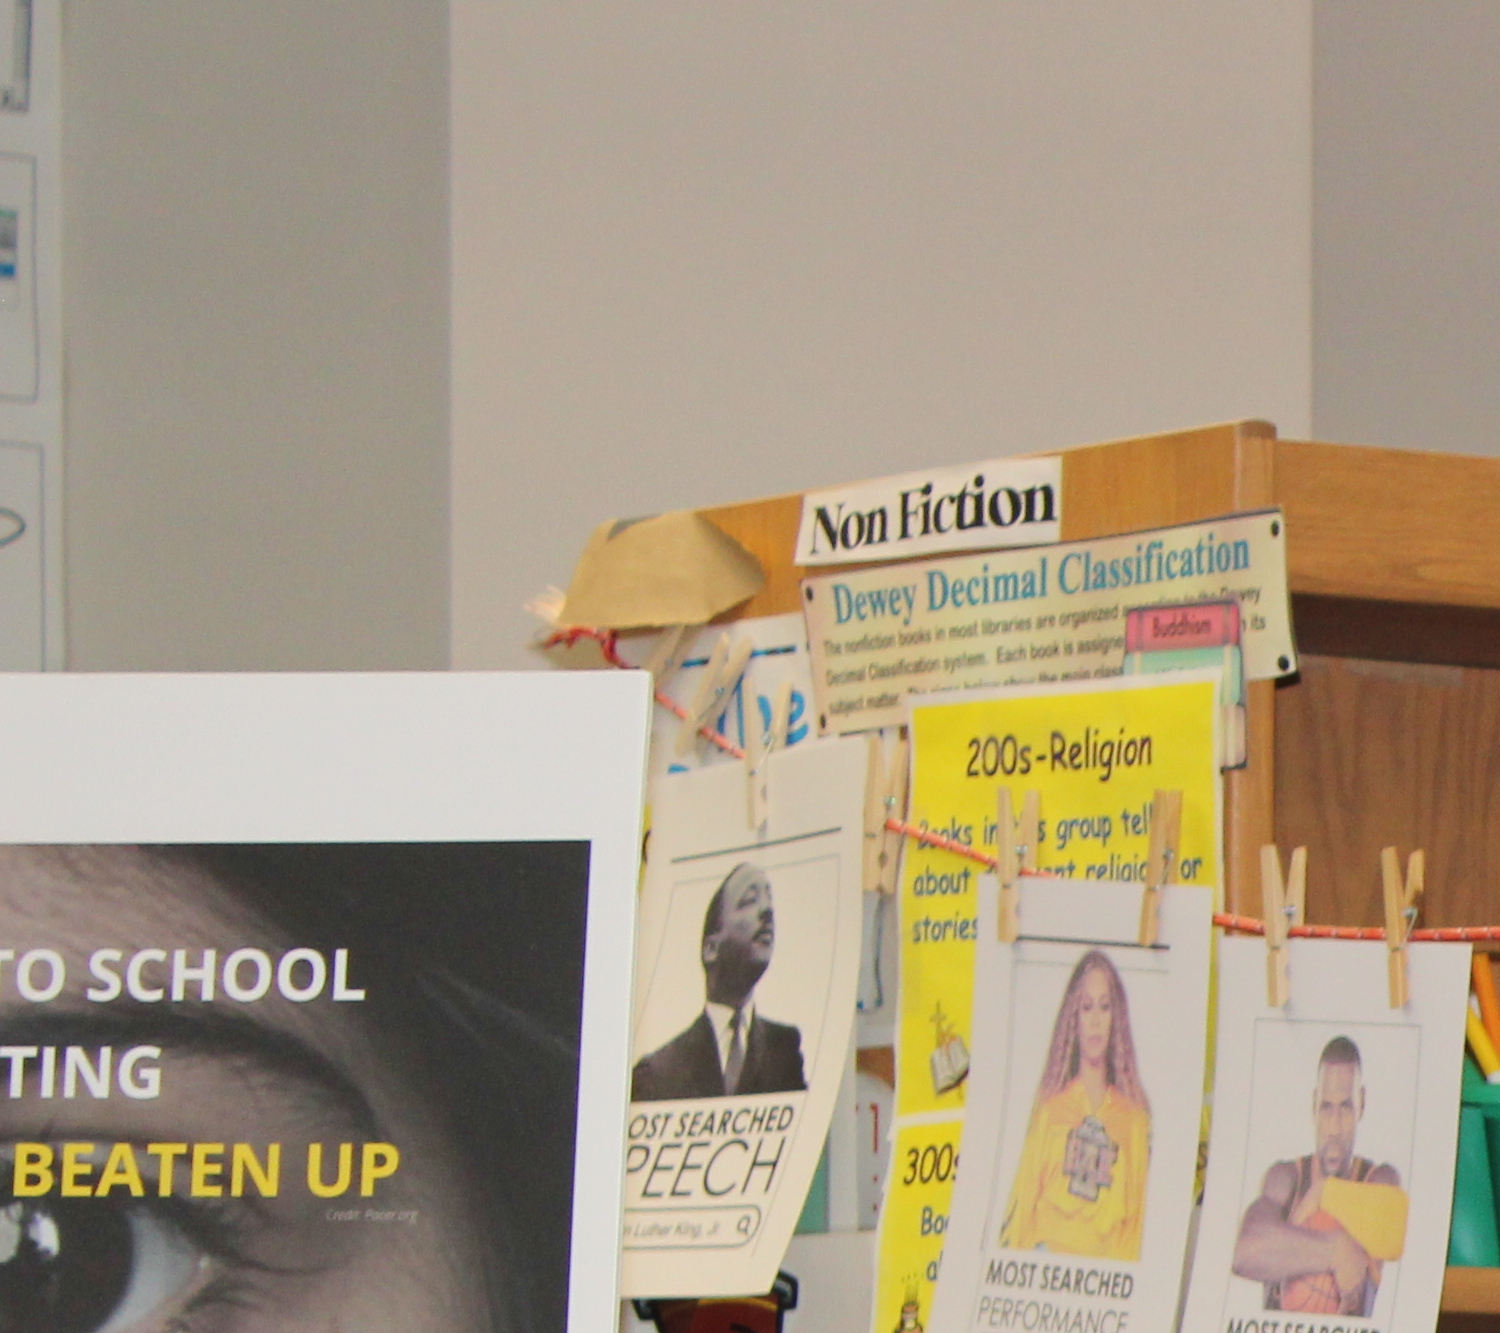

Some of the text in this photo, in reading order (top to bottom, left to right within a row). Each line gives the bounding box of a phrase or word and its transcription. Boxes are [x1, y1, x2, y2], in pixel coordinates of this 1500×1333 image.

[809, 474, 1057, 555] Non Fiction
[833, 532, 1251, 626] Dewey Decimal Classification
[965, 728, 1153, 780] 200s-Religion
[1056, 805, 1113, 850] group
[912, 857, 1204, 896] about or
[86, 947, 367, 1003] SCHOOL
[673, 1104, 795, 1139] SEARCHED
[12, 1141, 401, 1199] BEATEN UP
[985, 1258, 1134, 1299] MOST SEARCHED
